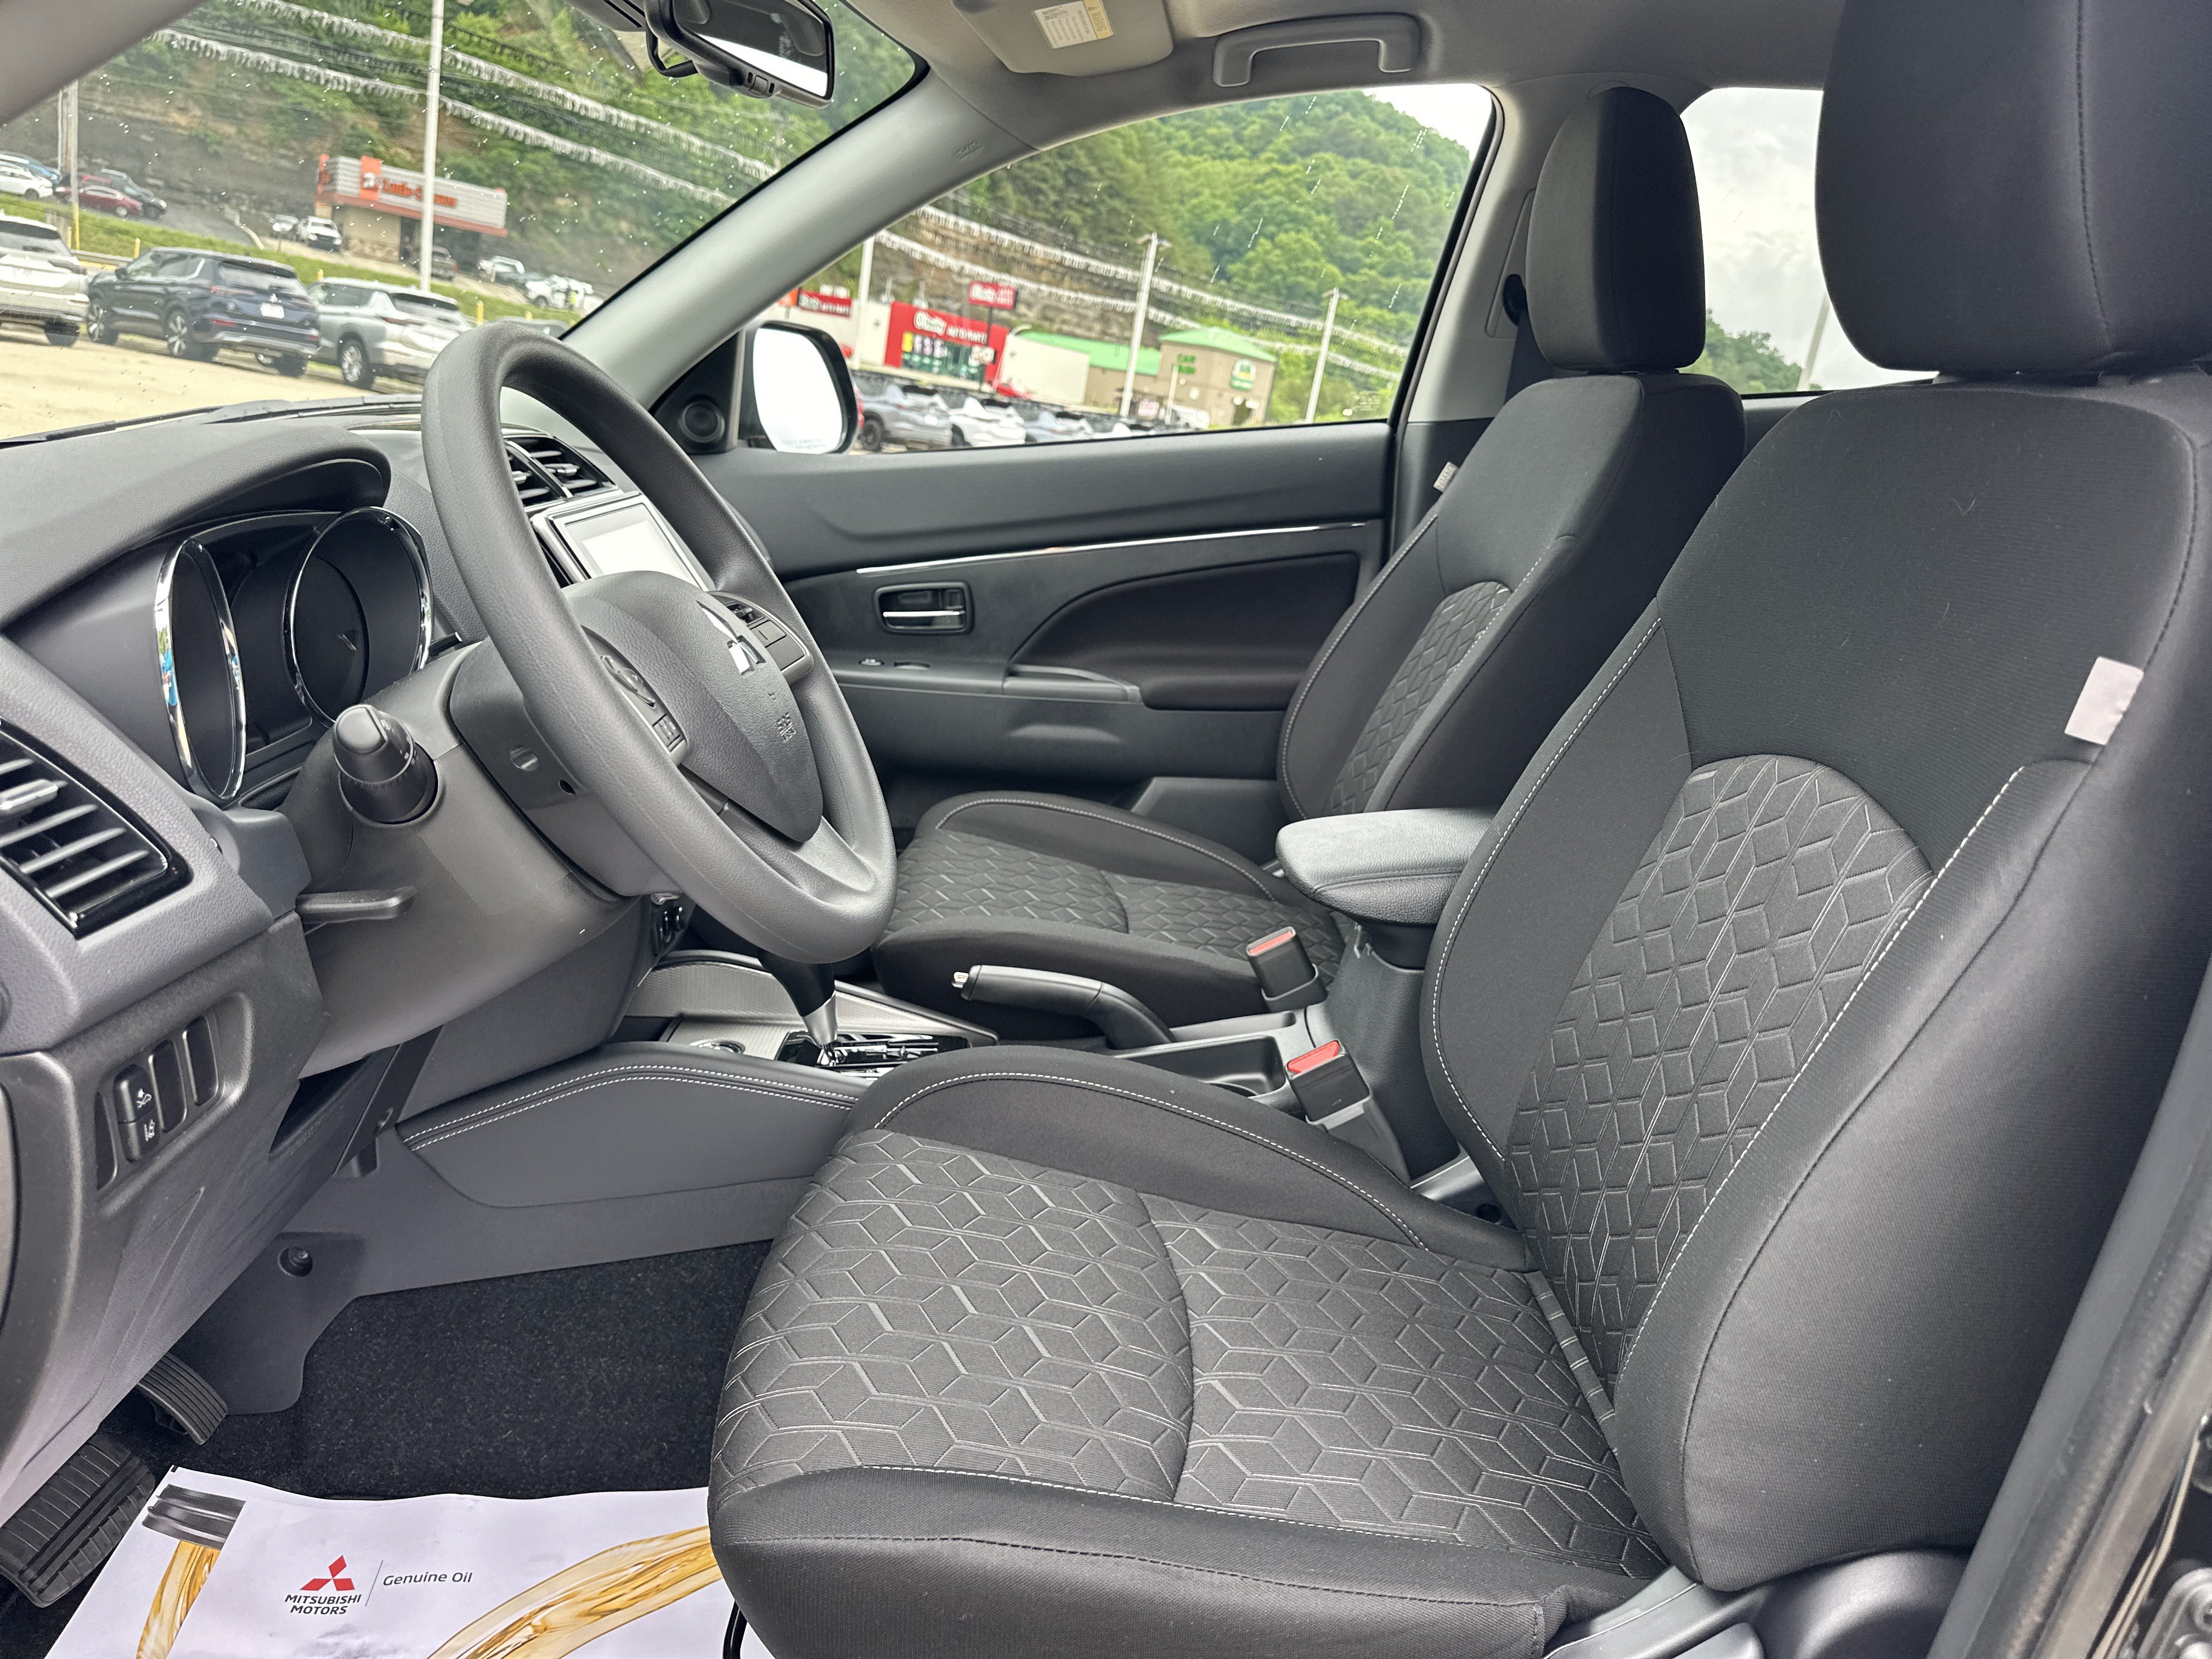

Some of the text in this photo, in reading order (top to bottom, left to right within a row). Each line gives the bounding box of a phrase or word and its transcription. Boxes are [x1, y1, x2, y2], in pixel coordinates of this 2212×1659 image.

[383, 1572, 473, 1585] Genuine Oil
[284, 1594, 362, 1604] MITSUBISHI
[290, 1605, 348, 1615] MOTORS
